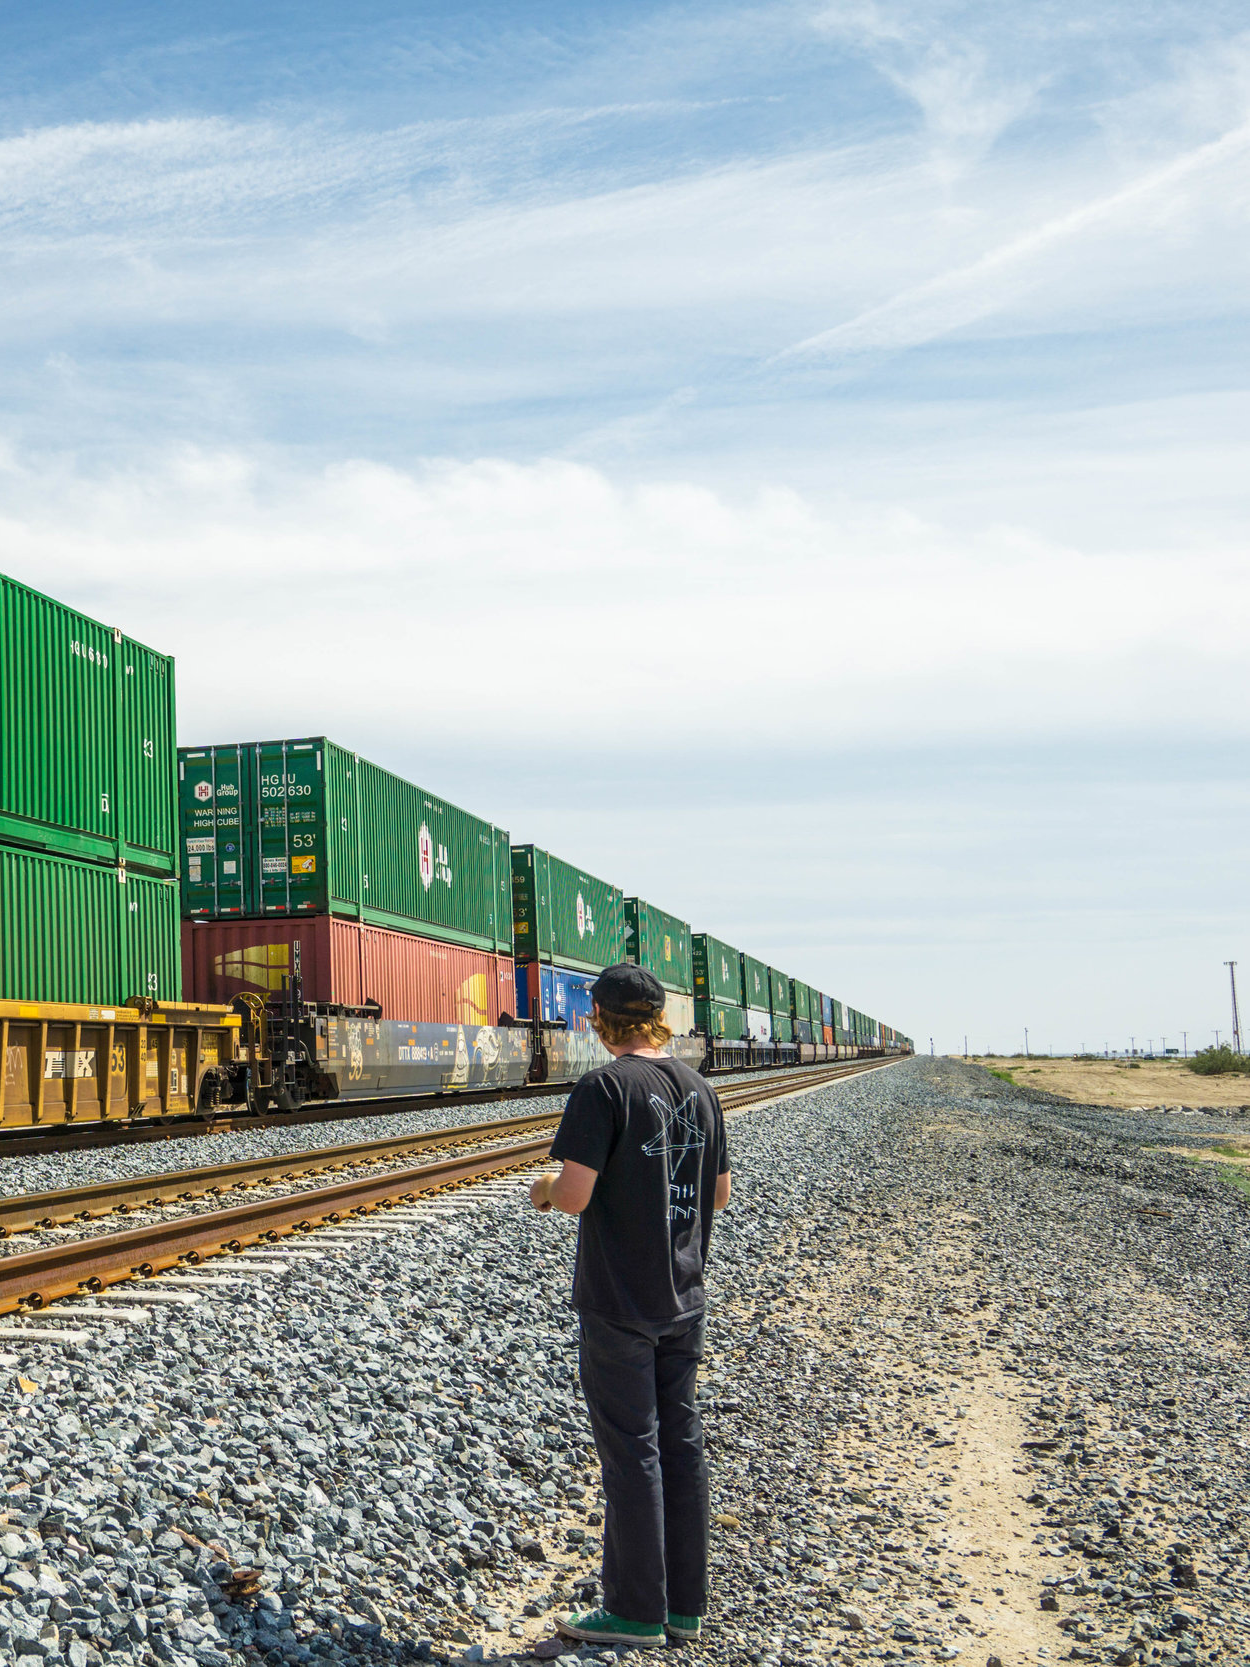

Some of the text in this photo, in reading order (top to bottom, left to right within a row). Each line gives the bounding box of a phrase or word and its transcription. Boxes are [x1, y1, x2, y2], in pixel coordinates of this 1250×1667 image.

[216, 788, 239, 797] Group
[220, 783, 235, 791] Hub
[261, 785, 312, 798] 502630
[293, 833, 317, 849] 53'
